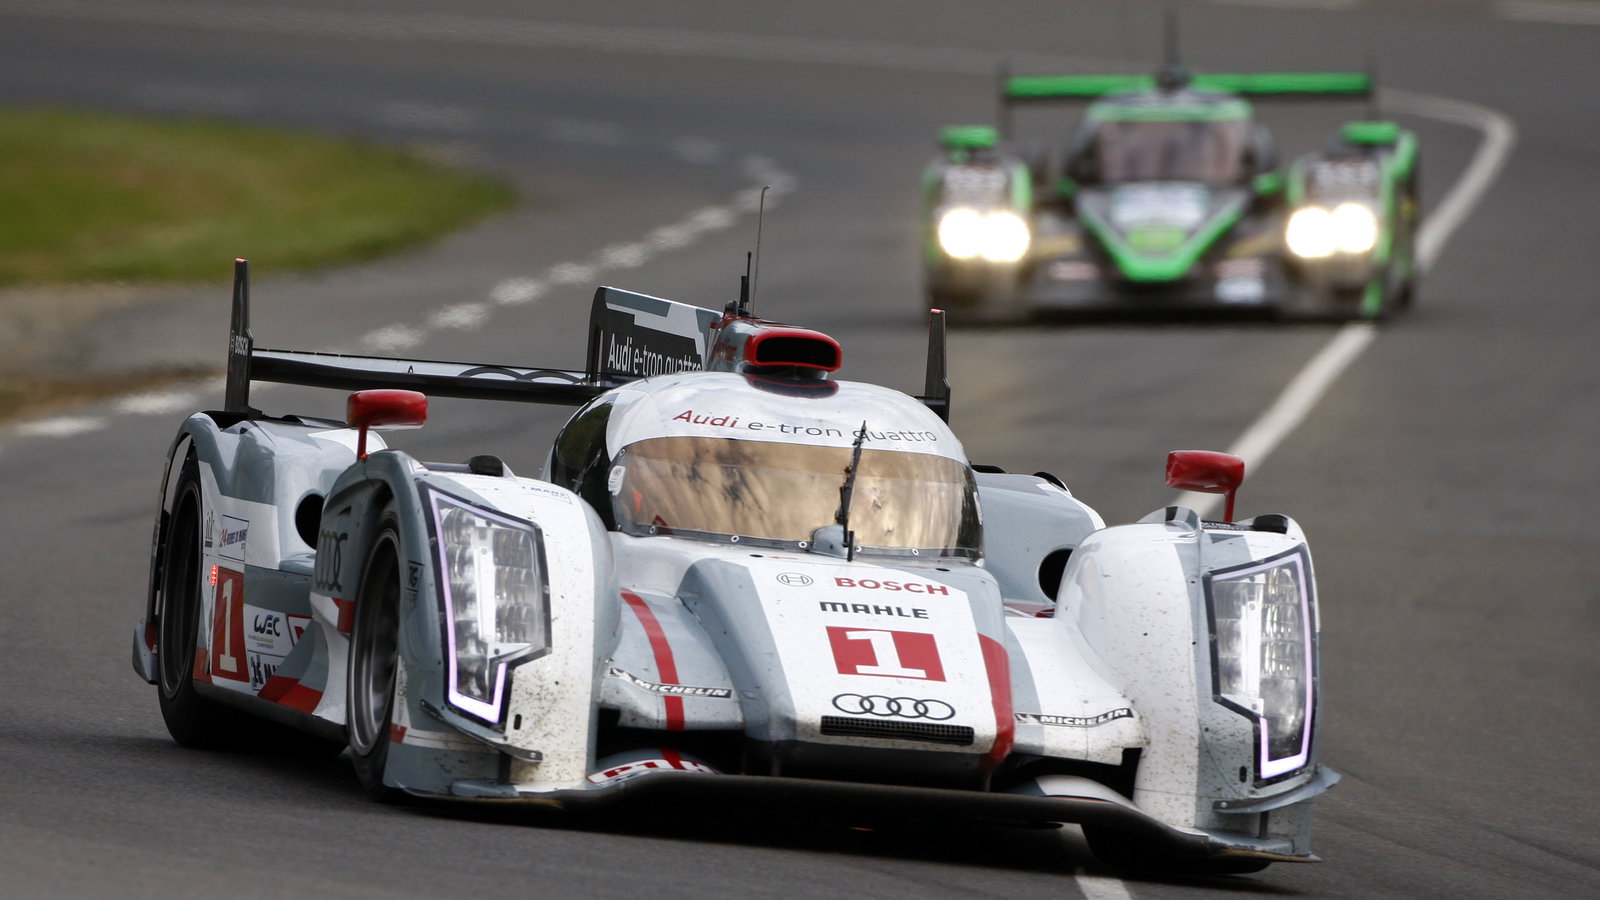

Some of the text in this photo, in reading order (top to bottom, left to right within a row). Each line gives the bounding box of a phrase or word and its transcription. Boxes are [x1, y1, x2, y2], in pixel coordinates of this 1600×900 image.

[608, 333, 633, 373] Audi
[633, 344, 663, 378] e-tron
[672, 409, 938, 444] Audi e-tron quattro
[834, 577, 950, 596] BOSCH
[819, 601, 930, 620] MAHLE
[219, 578, 238, 673] 1
[253, 614, 281, 638] WEC
[845, 630, 928, 679] 1
[633, 679, 729, 697] MICHELIN
[1039, 708, 1129, 726] MICHELIN
